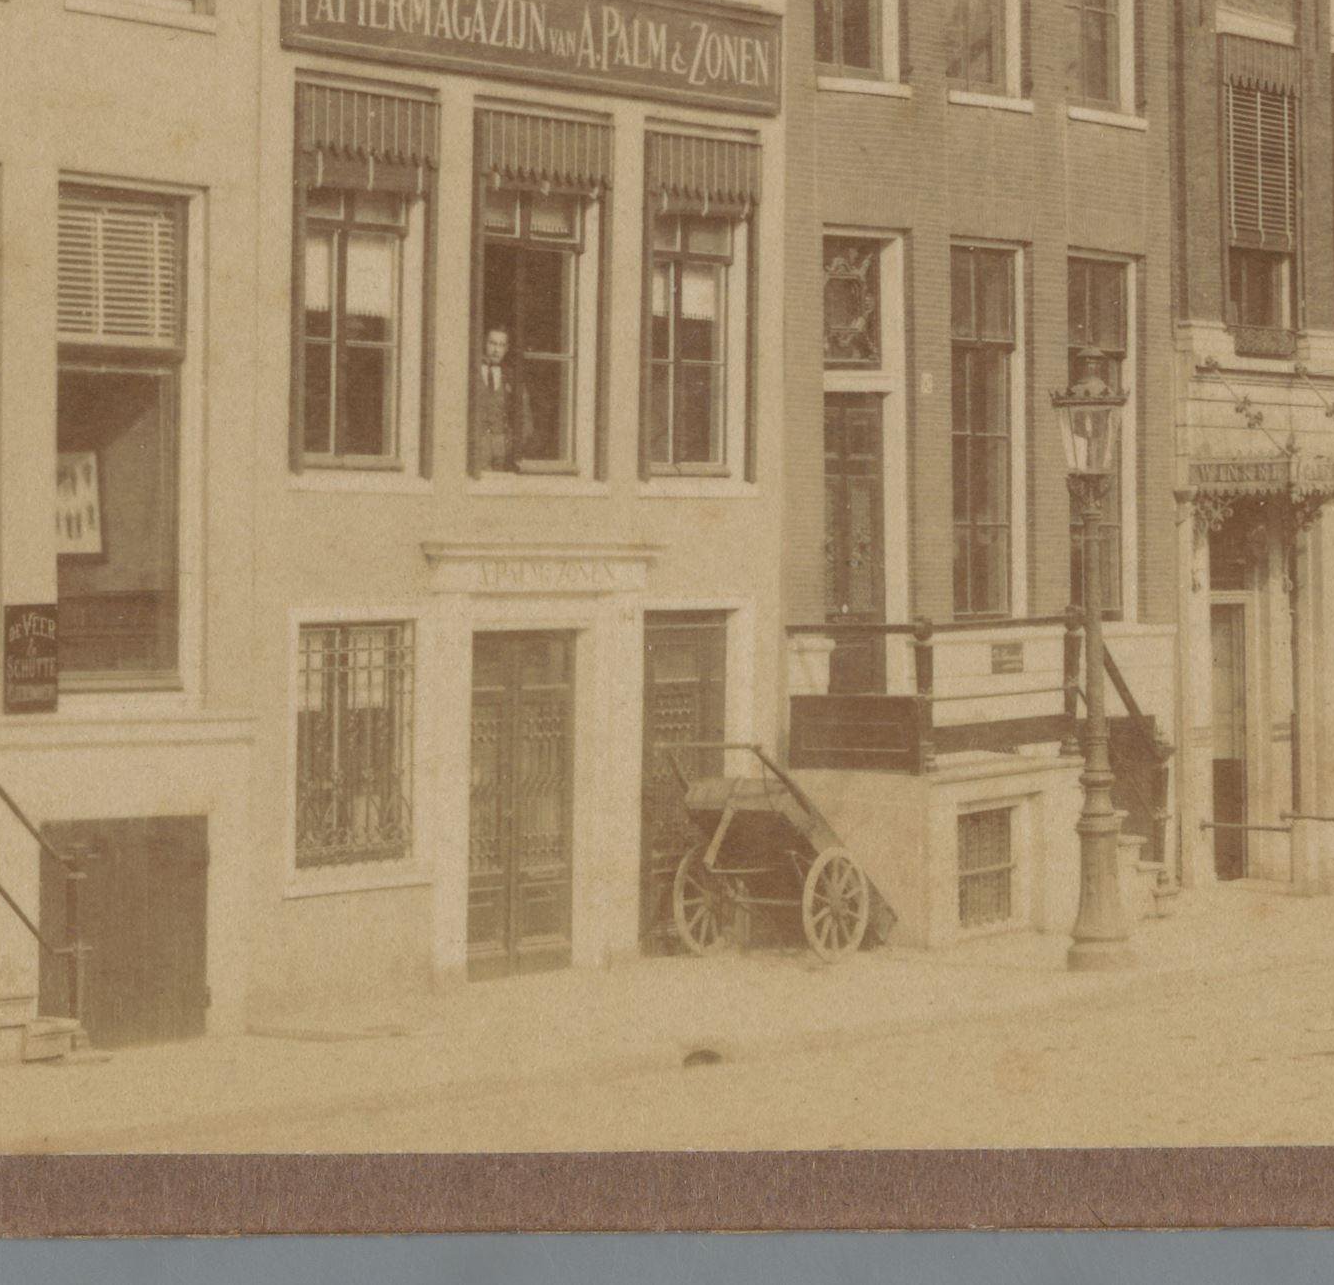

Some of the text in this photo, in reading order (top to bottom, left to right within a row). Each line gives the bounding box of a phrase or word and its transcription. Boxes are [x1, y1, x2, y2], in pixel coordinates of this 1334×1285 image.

[671, 43, 688, 75] &
[688, 22, 768, 86] ZONEN
[22, 612, 56, 640] VEER
